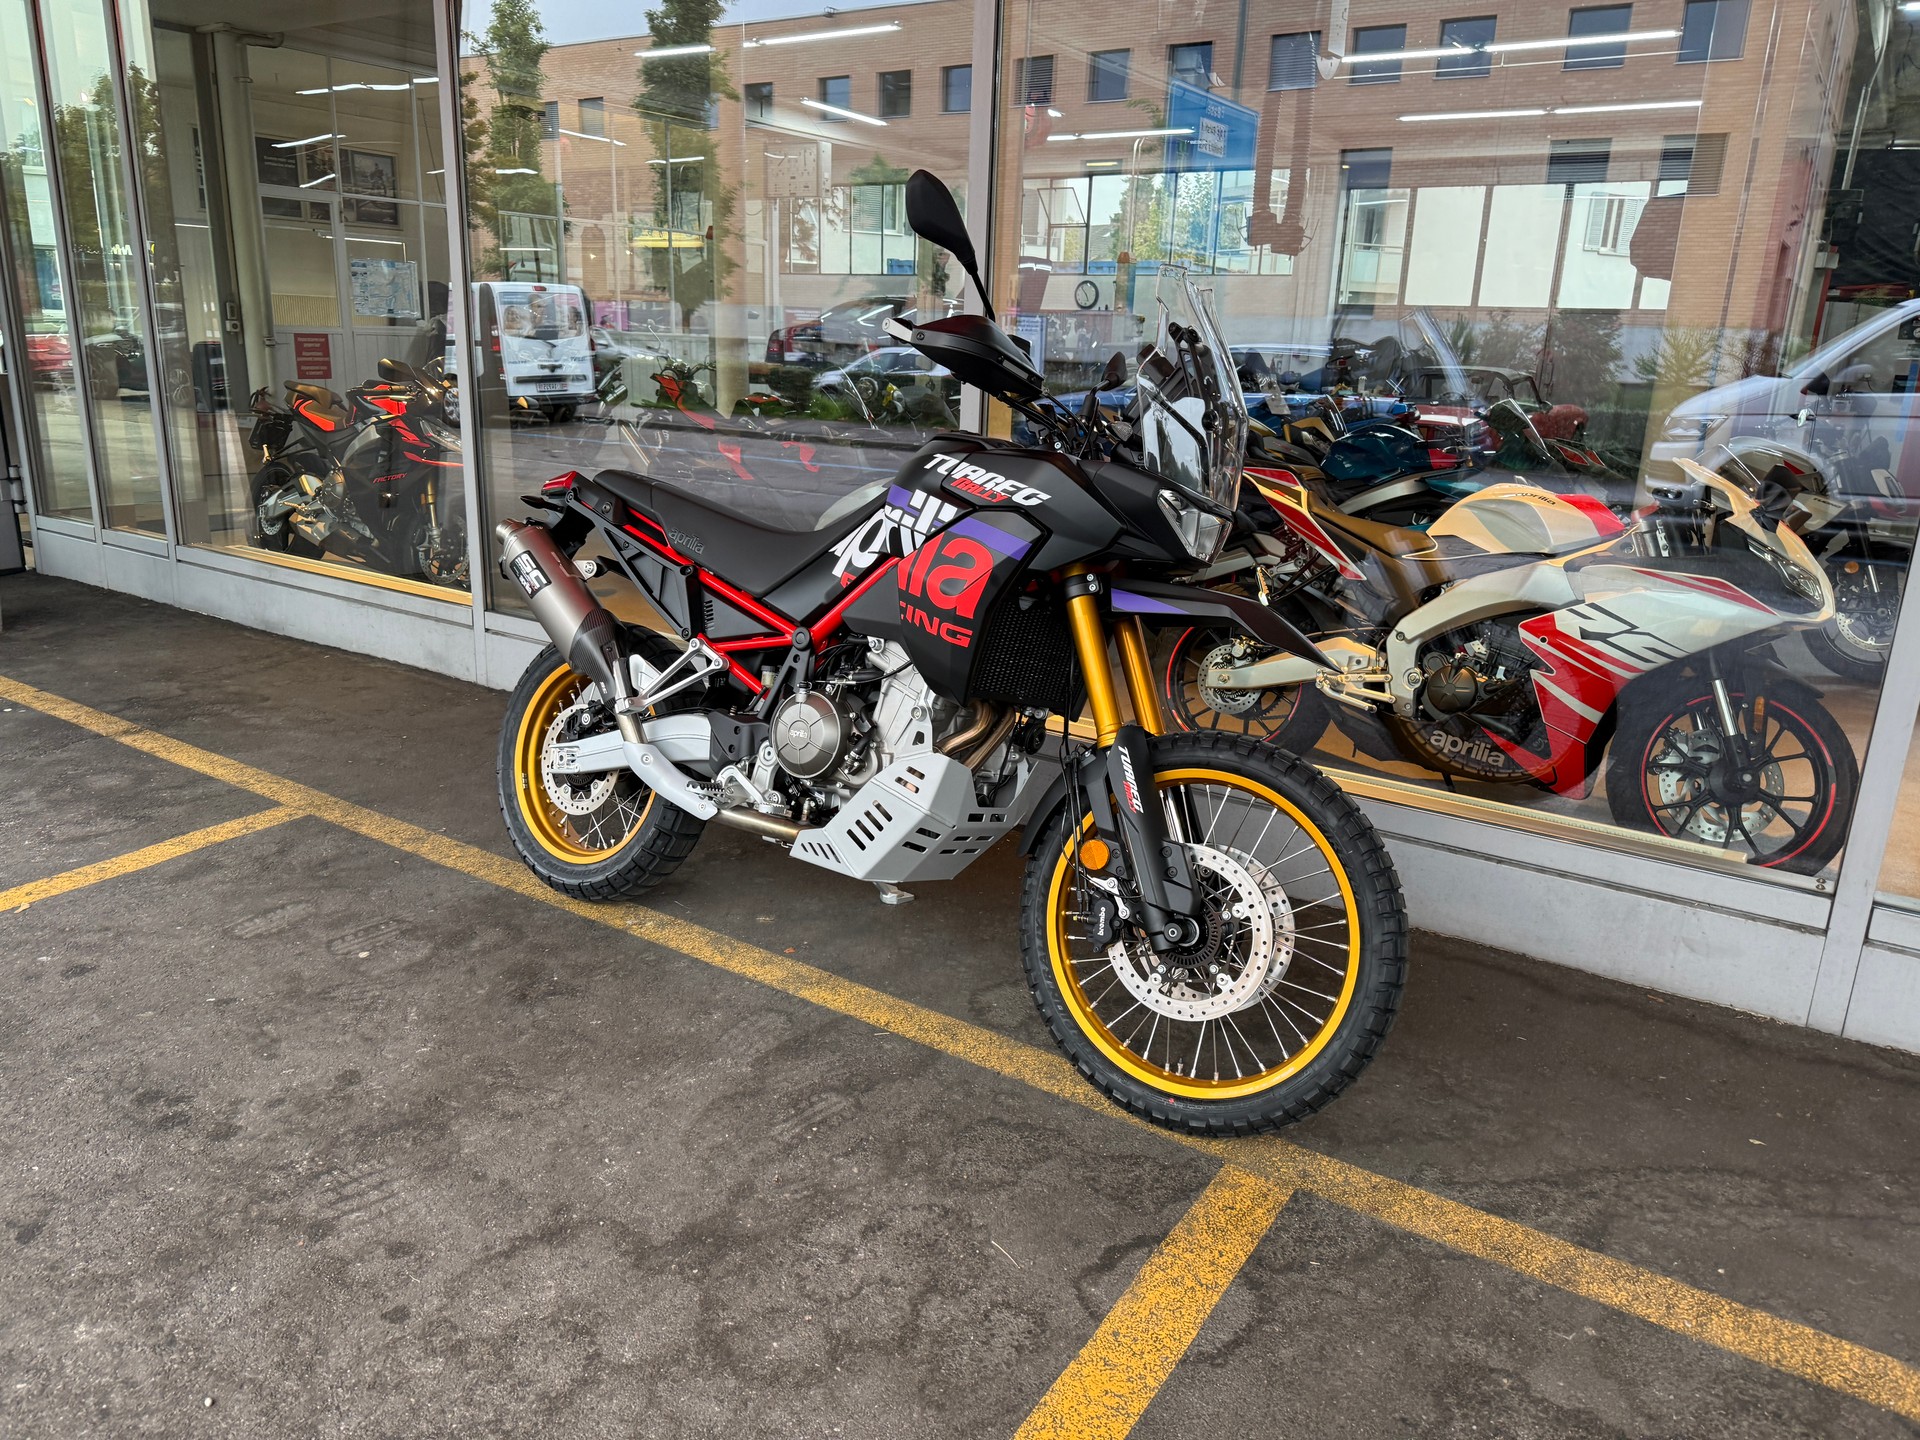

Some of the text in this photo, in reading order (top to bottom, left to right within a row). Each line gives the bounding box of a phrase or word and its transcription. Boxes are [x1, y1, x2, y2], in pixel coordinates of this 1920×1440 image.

[373, 472, 408, 484] FACTORY
[923, 453, 1052, 506] TUAREG
[950, 477, 1009, 503] RALLY
[1515, 492, 1556, 505] aprilia
[669, 527, 705, 555] aprilia
[520, 552, 548, 588] SC
[789, 729, 808, 739] aprilia
[1430, 730, 1505, 767] aprilia
[1118, 745, 1144, 814] TUAREG
[1096, 906, 1106, 936] brembo
